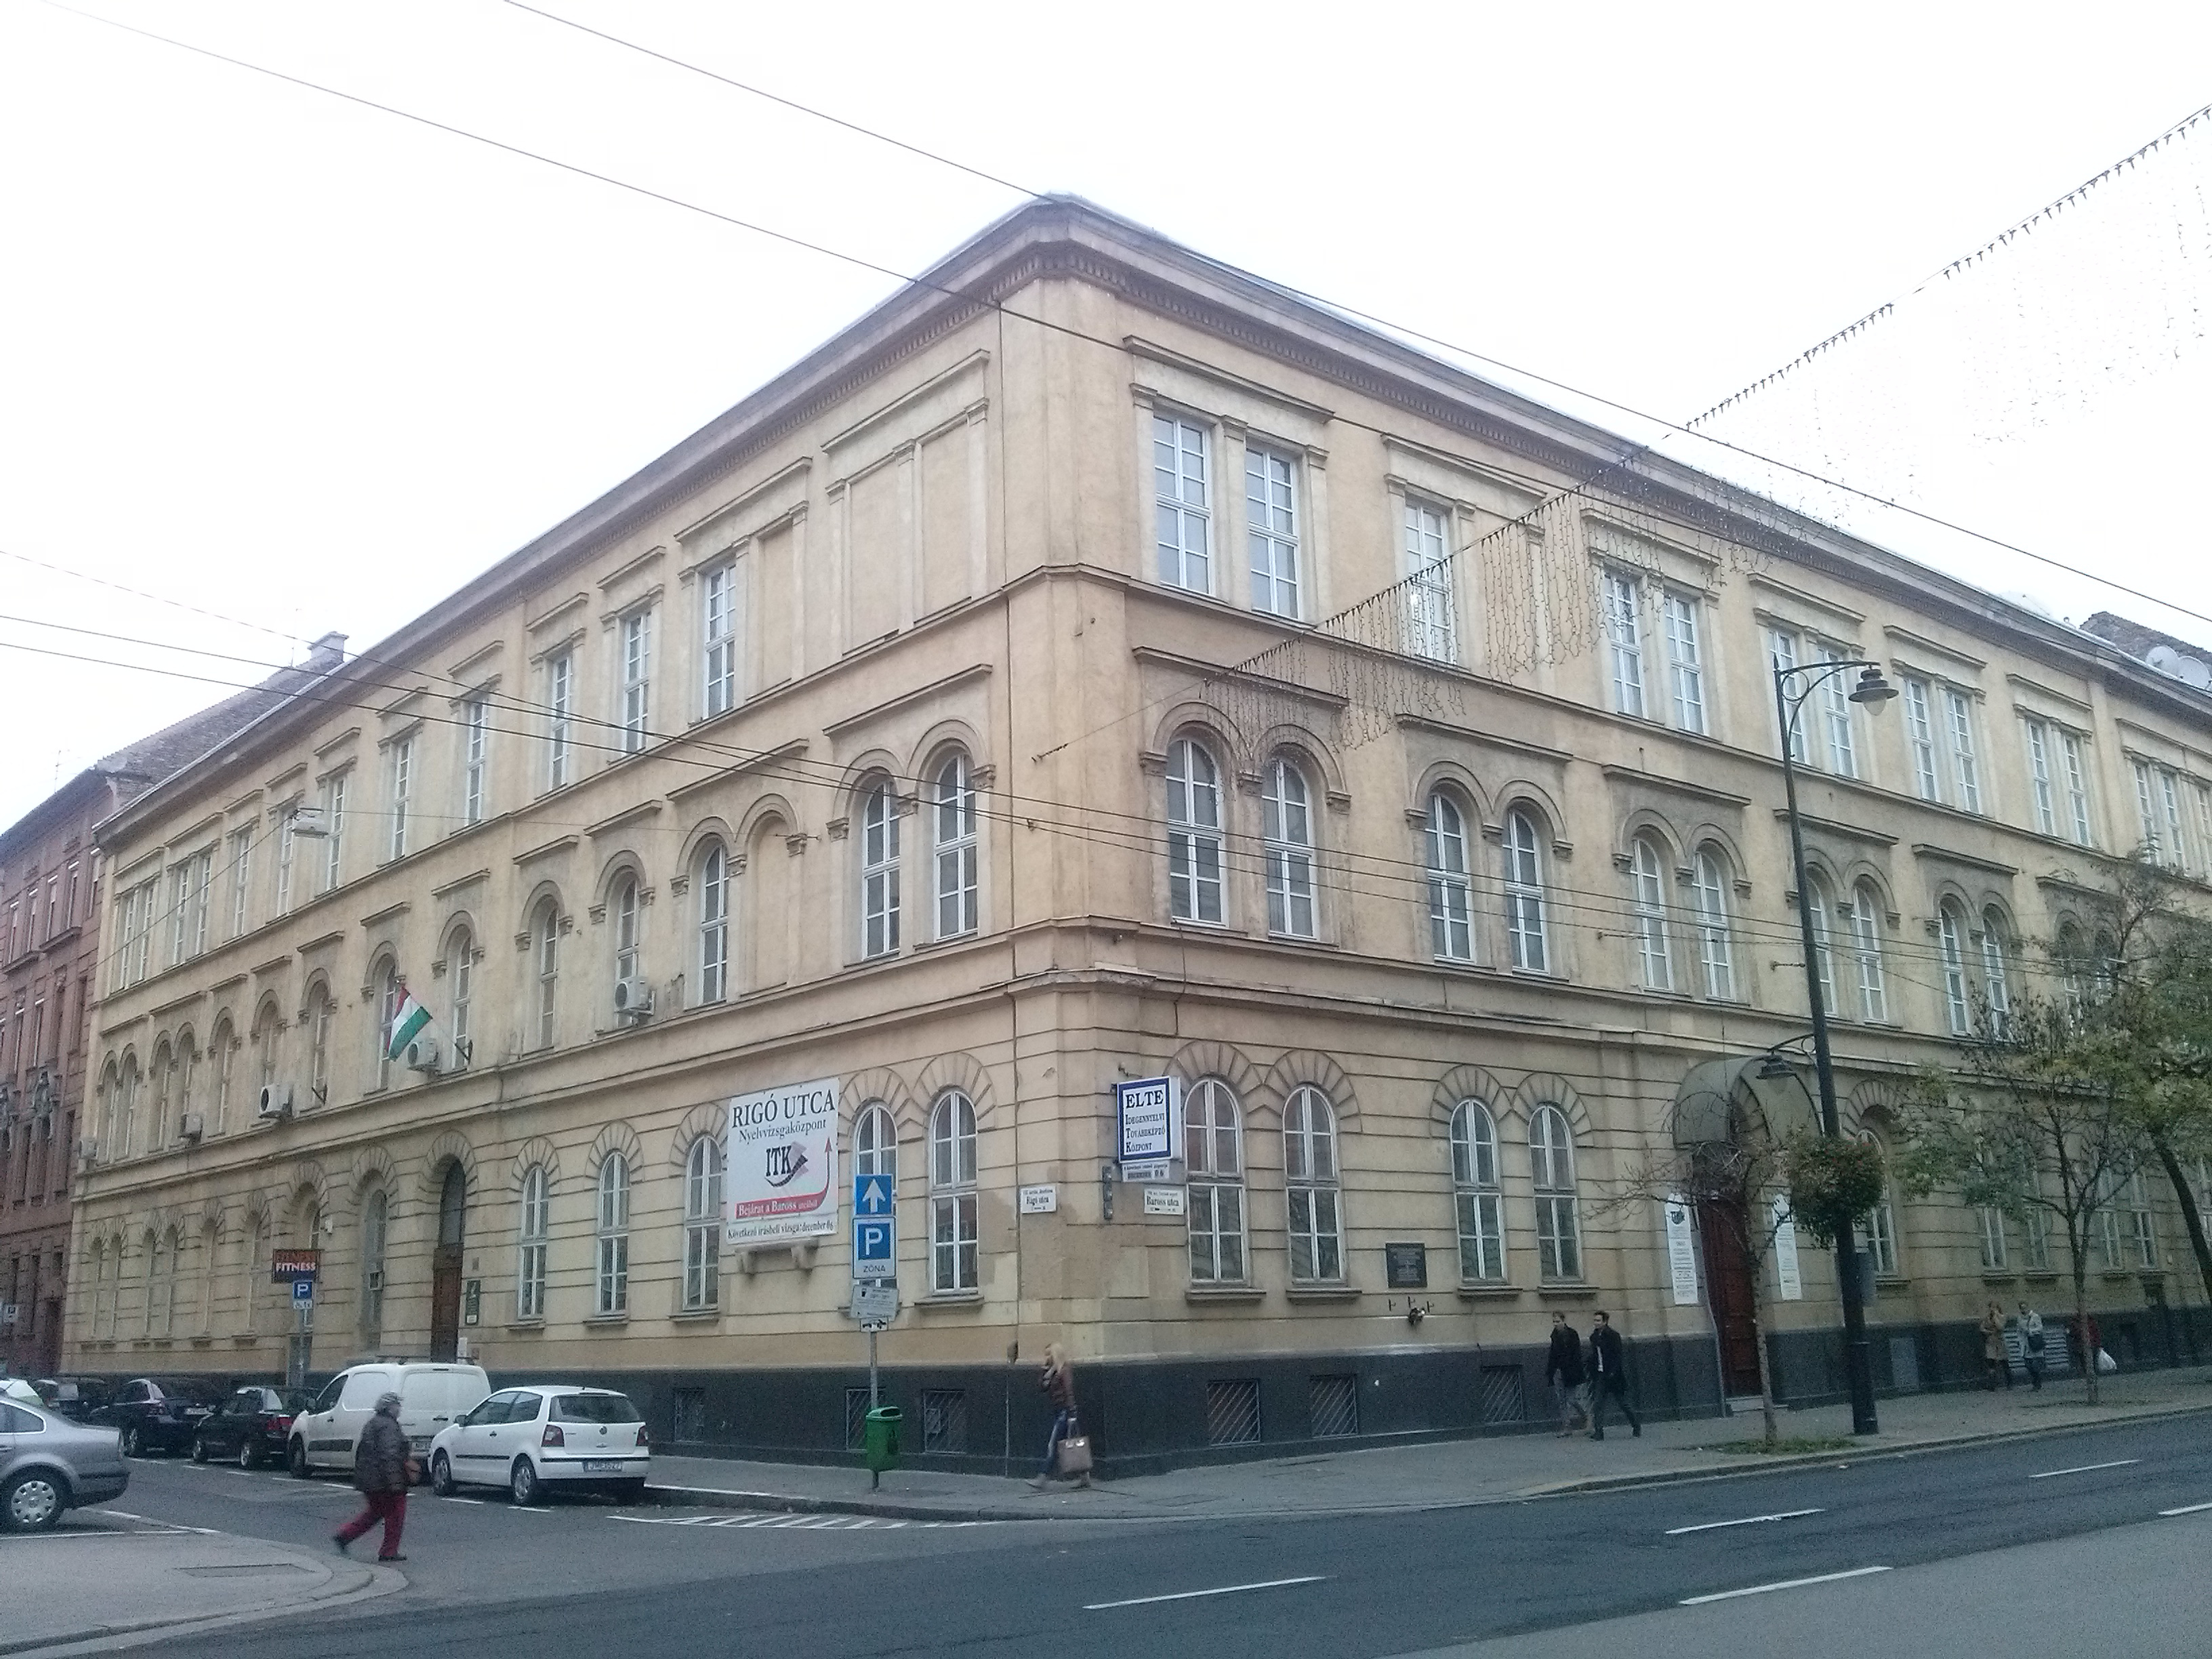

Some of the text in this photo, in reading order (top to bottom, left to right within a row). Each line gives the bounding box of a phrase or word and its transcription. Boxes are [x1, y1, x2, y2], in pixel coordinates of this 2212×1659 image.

[1125, 1090, 1164, 1109] ELTE
[732, 1088, 836, 1128] RIGÓ UTCA
[739, 1120, 827, 1145] Nyelvvizsgaközpont
[766, 1145, 792, 1177] ITK
[1038, 1195, 1049, 1204] utca
[1147, 1195, 1179, 1206] Baross utca
[739, 1204, 764, 1216] Bejárat
[771, 1201, 797, 1212] Baross
[865, 1227, 883, 1256] P
[276, 1262, 316, 1273] FITNESS
[863, 1263, 886, 1273] ZÓNA
[298, 1284, 308, 1297] P
